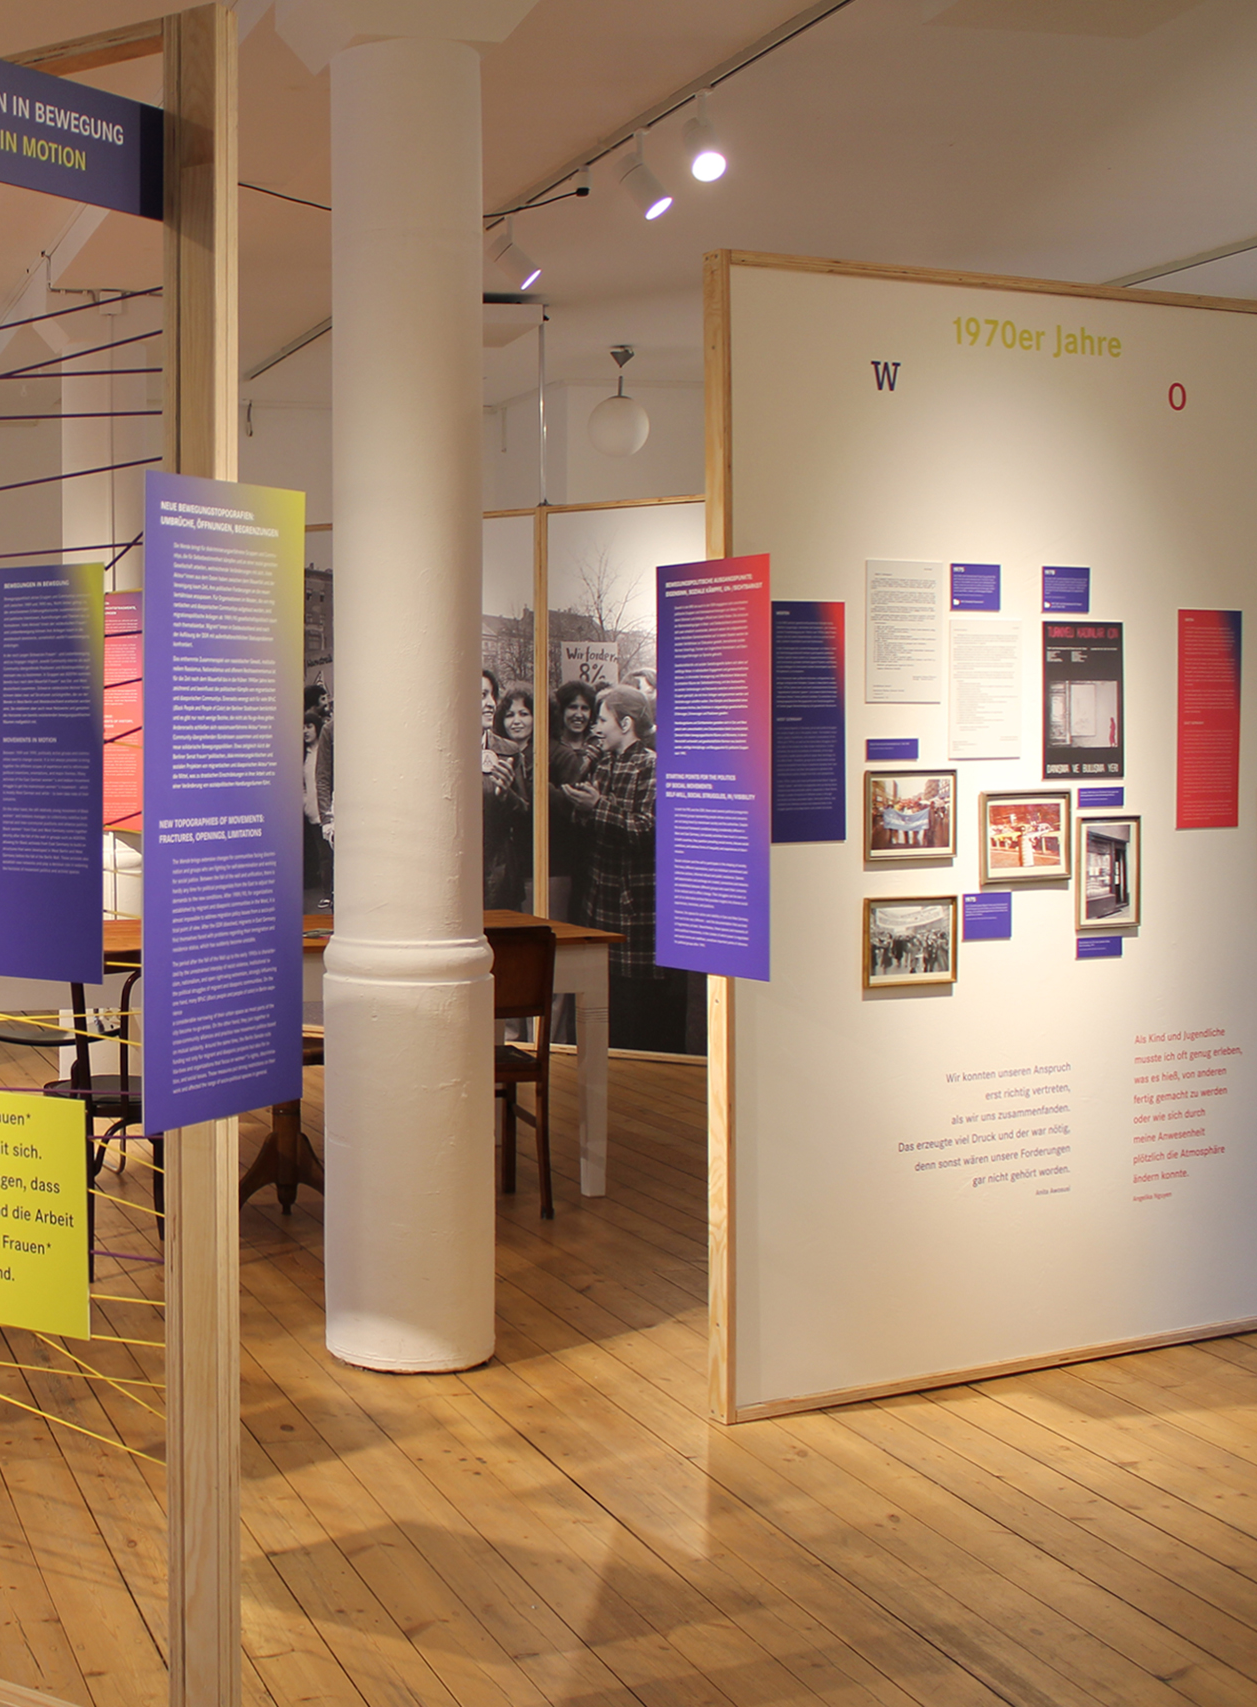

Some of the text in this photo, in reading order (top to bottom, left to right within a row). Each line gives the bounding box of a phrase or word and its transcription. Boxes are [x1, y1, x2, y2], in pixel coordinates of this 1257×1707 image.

[13, 96, 29, 119] IN
[36, 102, 124, 145] BEWEGUNG
[0, 129, 17, 153] IN
[23, 136, 86, 170] MOTION
[953, 317, 1122, 358] 1970er Jahre
[871, 361, 900, 391] W
[1169, 382, 1187, 411] O
[161, 501, 254, 520] NEUE BEWEGUNGSTOPOGRAFIEN:
[161, 515, 279, 537] UMBRÜCHE, ÖFFNUNGEN, BEGRENZUNGEN
[566, 648, 584, 659] Wir
[159, 814, 264, 828] NEW TOPOGRAPHIES OF MOVEMENTS:
[159, 828, 262, 843] FRACTURES, OPENINGS, LIMITATIONS
[1135, 1028, 1225, 1044] Als Kind und Jugendliche
[1135, 1046, 1242, 1064] musste ich oft genug erleben,
[946, 1062, 1071, 1083] Wir konnten unseren Anspruch
[1134, 1076, 1148, 1084] was
[1182, 1072, 1195, 1080] von
[1197, 1068, 1227, 1078] anderen
[985, 1083, 1071, 1100] erst richtig vertreten,
[1134, 1087, 1228, 1105] fertig gemacht zu werden
[898, 1142, 914, 1153] Das
[916, 1138, 952, 1150] erzeugte
[955, 1135, 969, 1146] viel
[972, 1132, 996, 1144] Druck
[998, 1130, 1013, 1141] und
[1016, 1129, 1029, 1139] der
[1031, 1127, 1046, 1136] war
[13, 1144, 42, 1160] sich.
[915, 1145, 1071, 1172] denn sonst wären unsere Forderungen
[1133, 1145, 1225, 1165] plötzlich die Atmosphäre
[30, 1177, 60, 1194] dass
[12, 1206, 30, 1221] die
[35, 1209, 73, 1228] Arbeit
